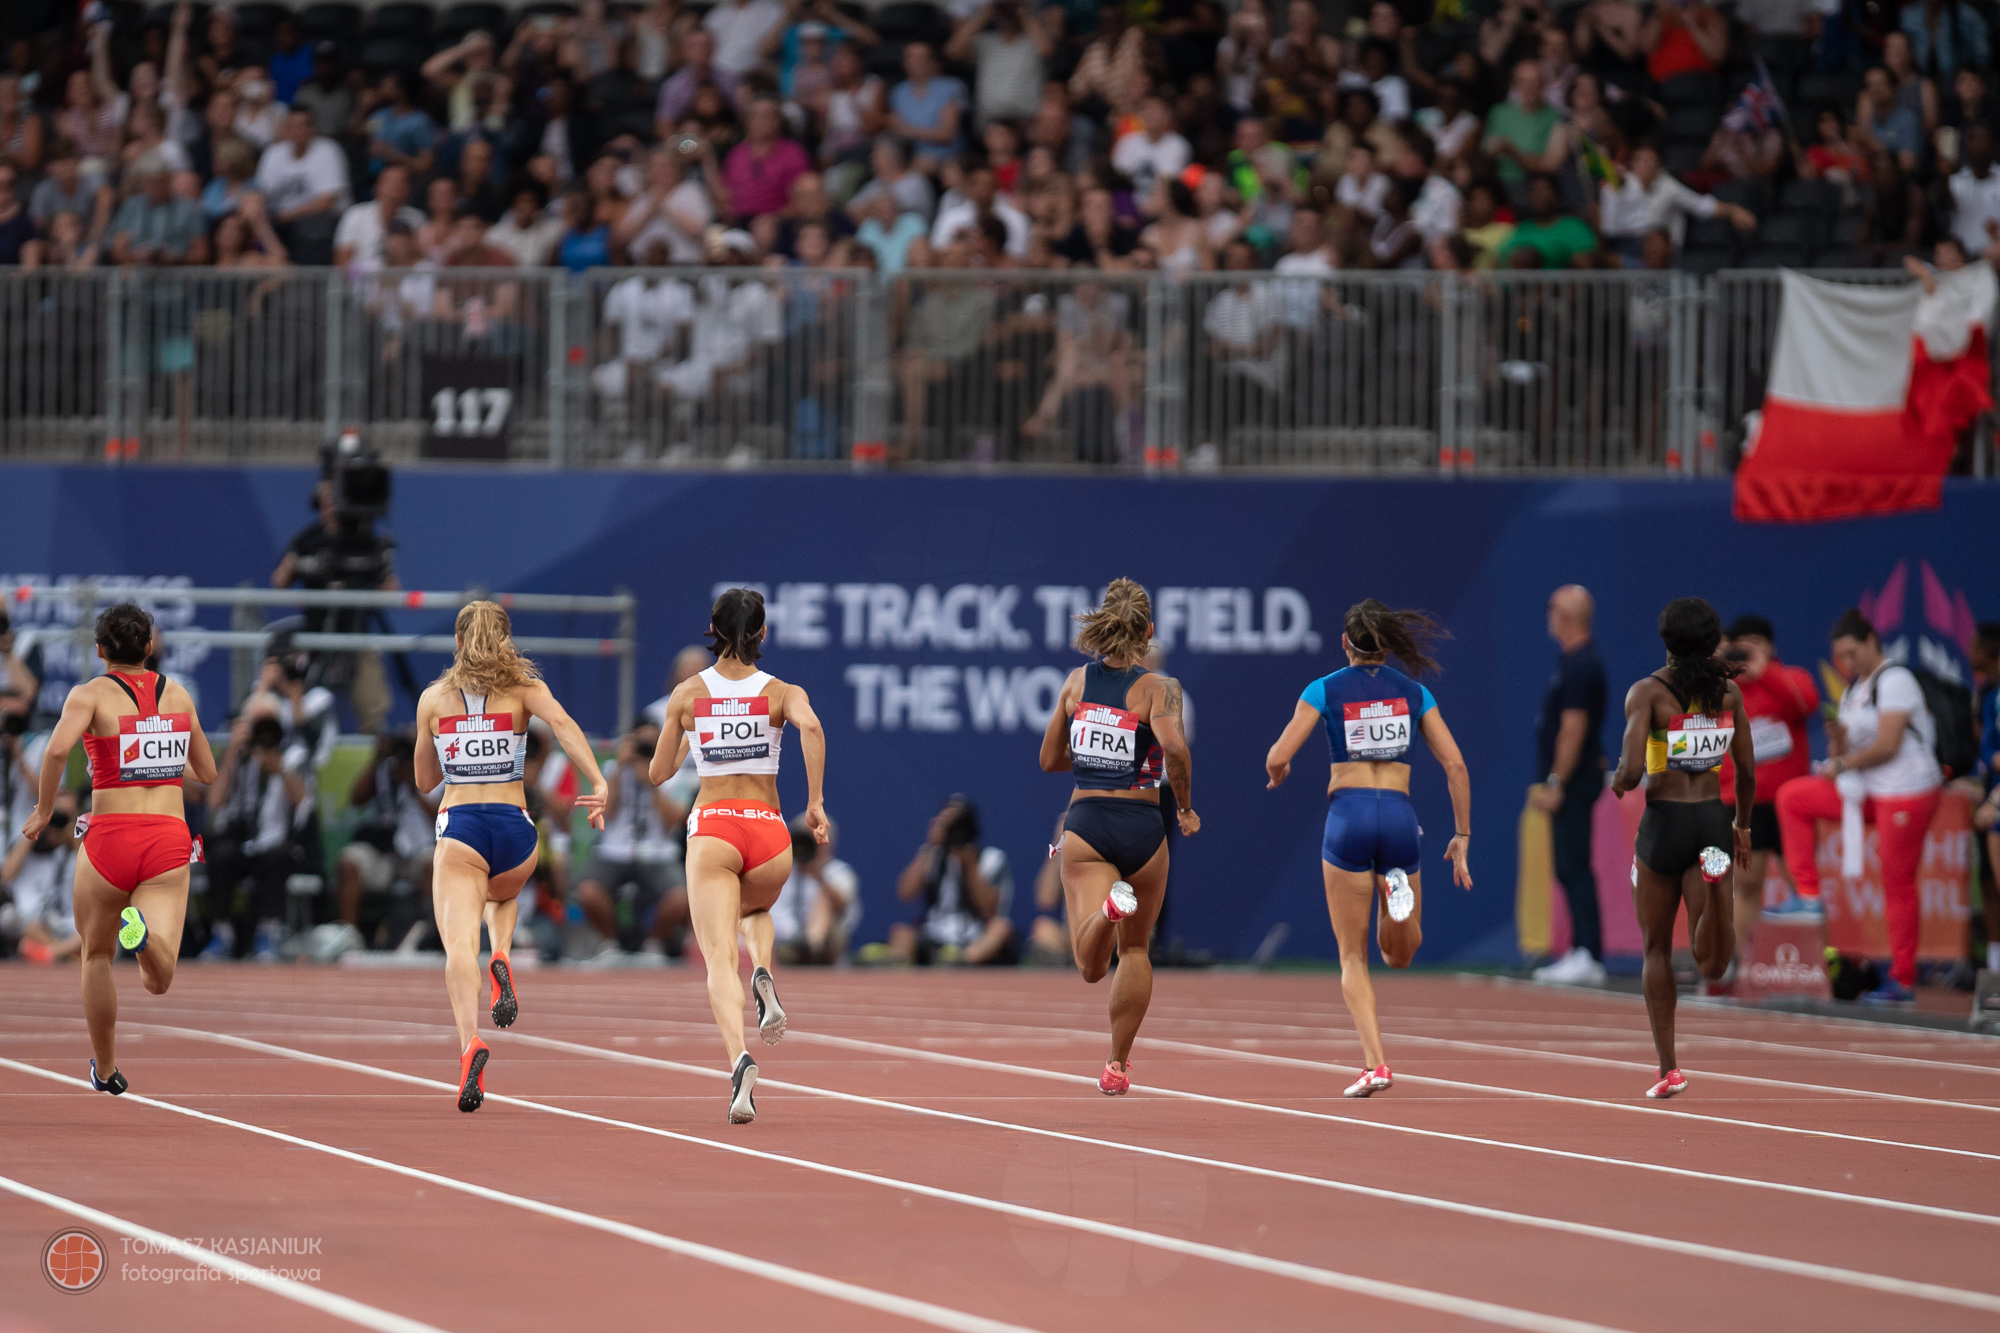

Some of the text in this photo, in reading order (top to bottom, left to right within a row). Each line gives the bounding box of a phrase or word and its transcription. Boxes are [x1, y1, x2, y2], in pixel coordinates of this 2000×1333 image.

[431, 387, 513, 438] 117
[833, 583, 1031, 650] TRACK.
[1156, 585, 1323, 653] FIELD.
[711, 698, 751, 716] müller
[845, 663, 961, 732] THE
[1086, 707, 1123, 727] müller
[1360, 702, 1393, 718] müller
[136, 715, 173, 733] müller
[456, 715, 495, 733] müller
[721, 722, 765, 740] POL
[1369, 722, 1407, 741] USA
[143, 739, 187, 759] CHN
[465, 738, 510, 757] GBR
[1090, 730, 1129, 754] FRA
[1692, 734, 1727, 756] JAM
[703, 808, 781, 823] POLSKA
